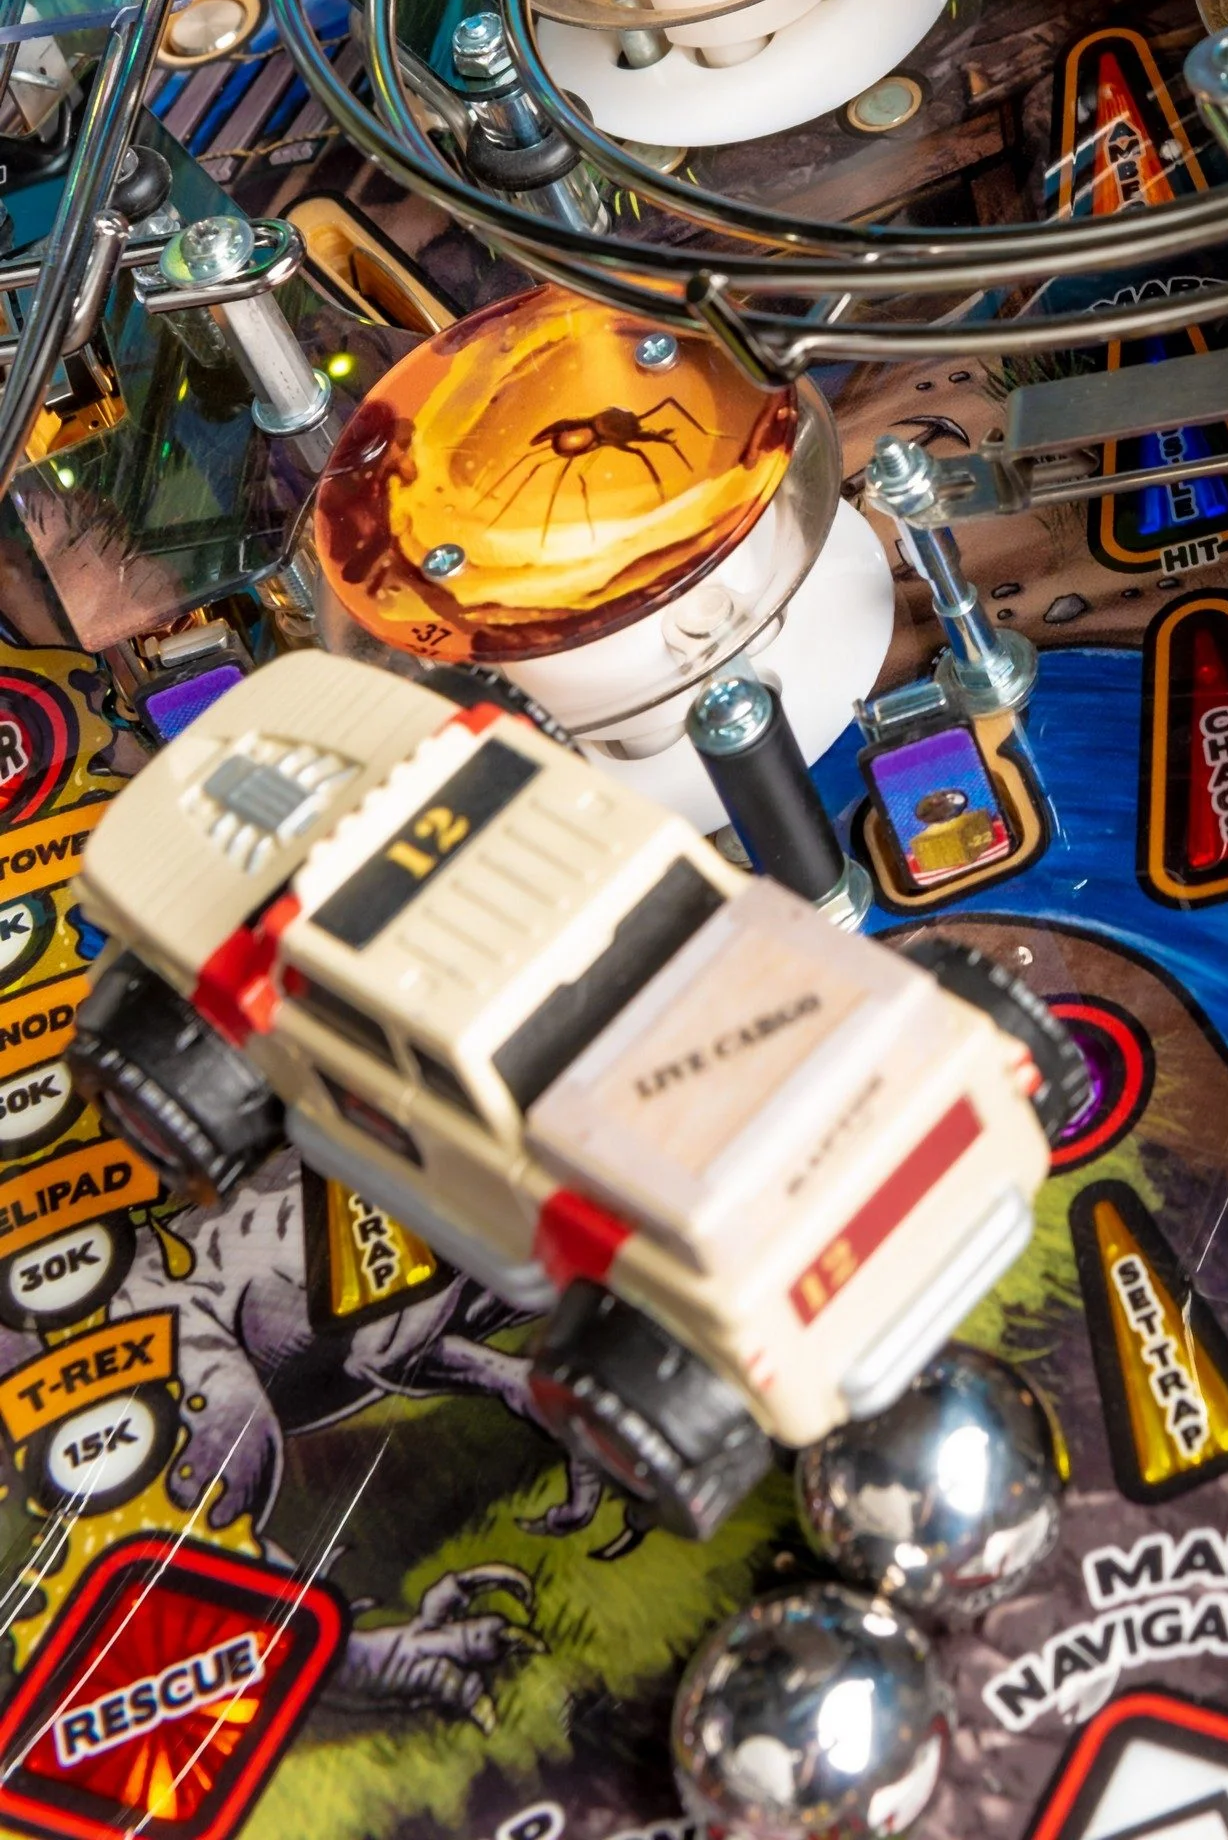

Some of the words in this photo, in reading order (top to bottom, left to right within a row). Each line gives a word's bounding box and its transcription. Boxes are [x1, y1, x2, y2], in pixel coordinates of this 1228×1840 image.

[1162, 535, 1221, 573] HIT
[411, 623, 453, 647] -37
[386, 806, 470, 880] 12
[18, 1239, 102, 1292] 30K
[17, 1332, 156, 1413] T-REX
[1115, 1259, 1160, 1336] SET
[1147, 1340, 1204, 1452] TRAP
[62, 1417, 138, 1469] 15K
[60, 1636, 261, 1759] RESCUE
